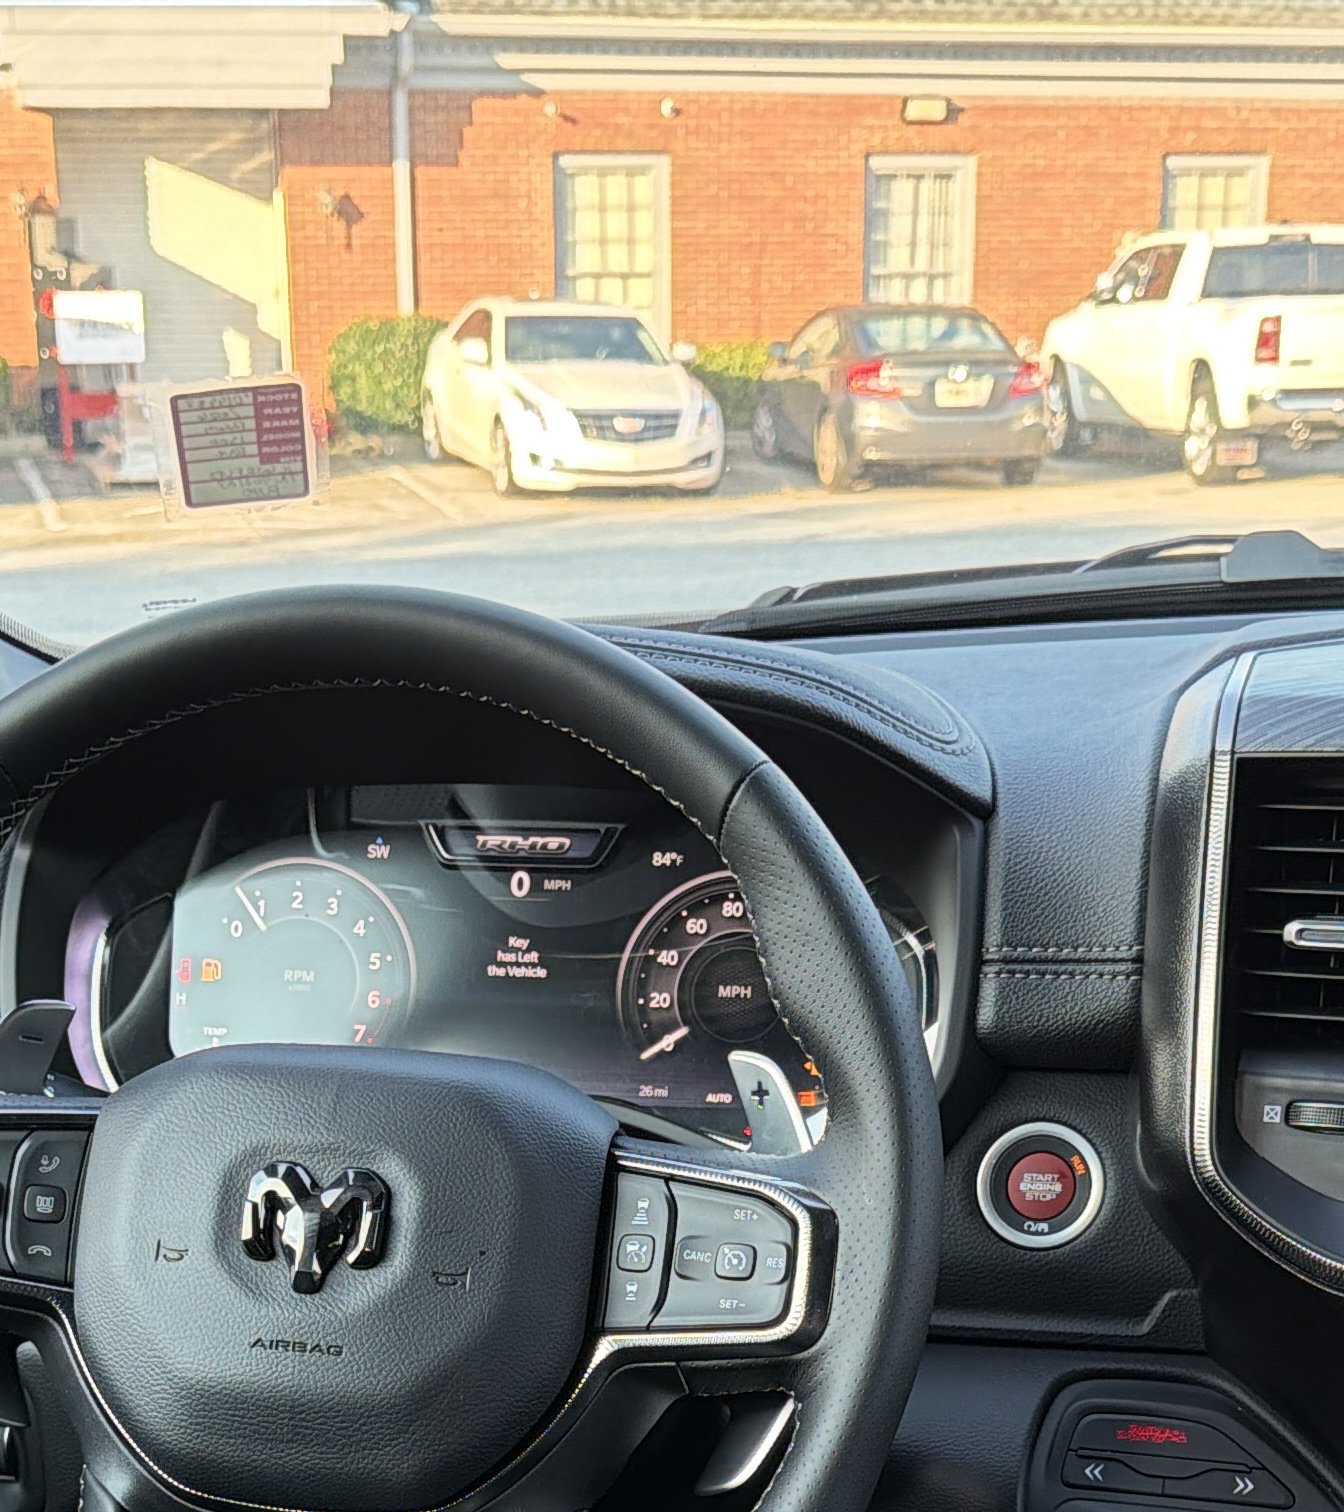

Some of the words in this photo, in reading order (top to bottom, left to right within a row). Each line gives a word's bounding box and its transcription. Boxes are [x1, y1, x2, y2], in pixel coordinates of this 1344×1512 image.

[367, 844, 391, 860] SW
[510, 871, 531, 898] 0
[543, 879, 572, 892] MPH
[258, 899, 266, 917] 1
[291, 891, 304, 909] 2
[326, 898, 339, 916] 3
[722, 901, 744, 918] 80
[230, 921, 243, 938] 0
[353, 919, 366, 937] 4
[686, 918, 708, 935] 60
[508, 935, 530, 950] Key
[369, 953, 381, 970] 5
[496, 951, 518, 964] has
[519, 951, 540, 964] Left
[656, 950, 679, 966] 40
[284, 970, 315, 983] RPM
[487, 965, 505, 977] the
[506, 965, 547, 979] Vehicle
[367, 991, 381, 1008] 6
[717, 985, 752, 999] MPH
[649, 993, 671, 1008] 20
[203, 1026, 228, 1037] TEMP
[353, 1025, 367, 1043] 7
[706, 1093, 733, 1103] AUTO
[1023, 1173, 1060, 1181] START
[1019, 1182, 1063, 1192] ENGINE
[1025, 1192, 1057, 1202] STOP
[683, 1249, 712, 1263] CANC
[766, 1257, 785, 1269] RES
[249, 1337, 344, 1357] AIRBAG
